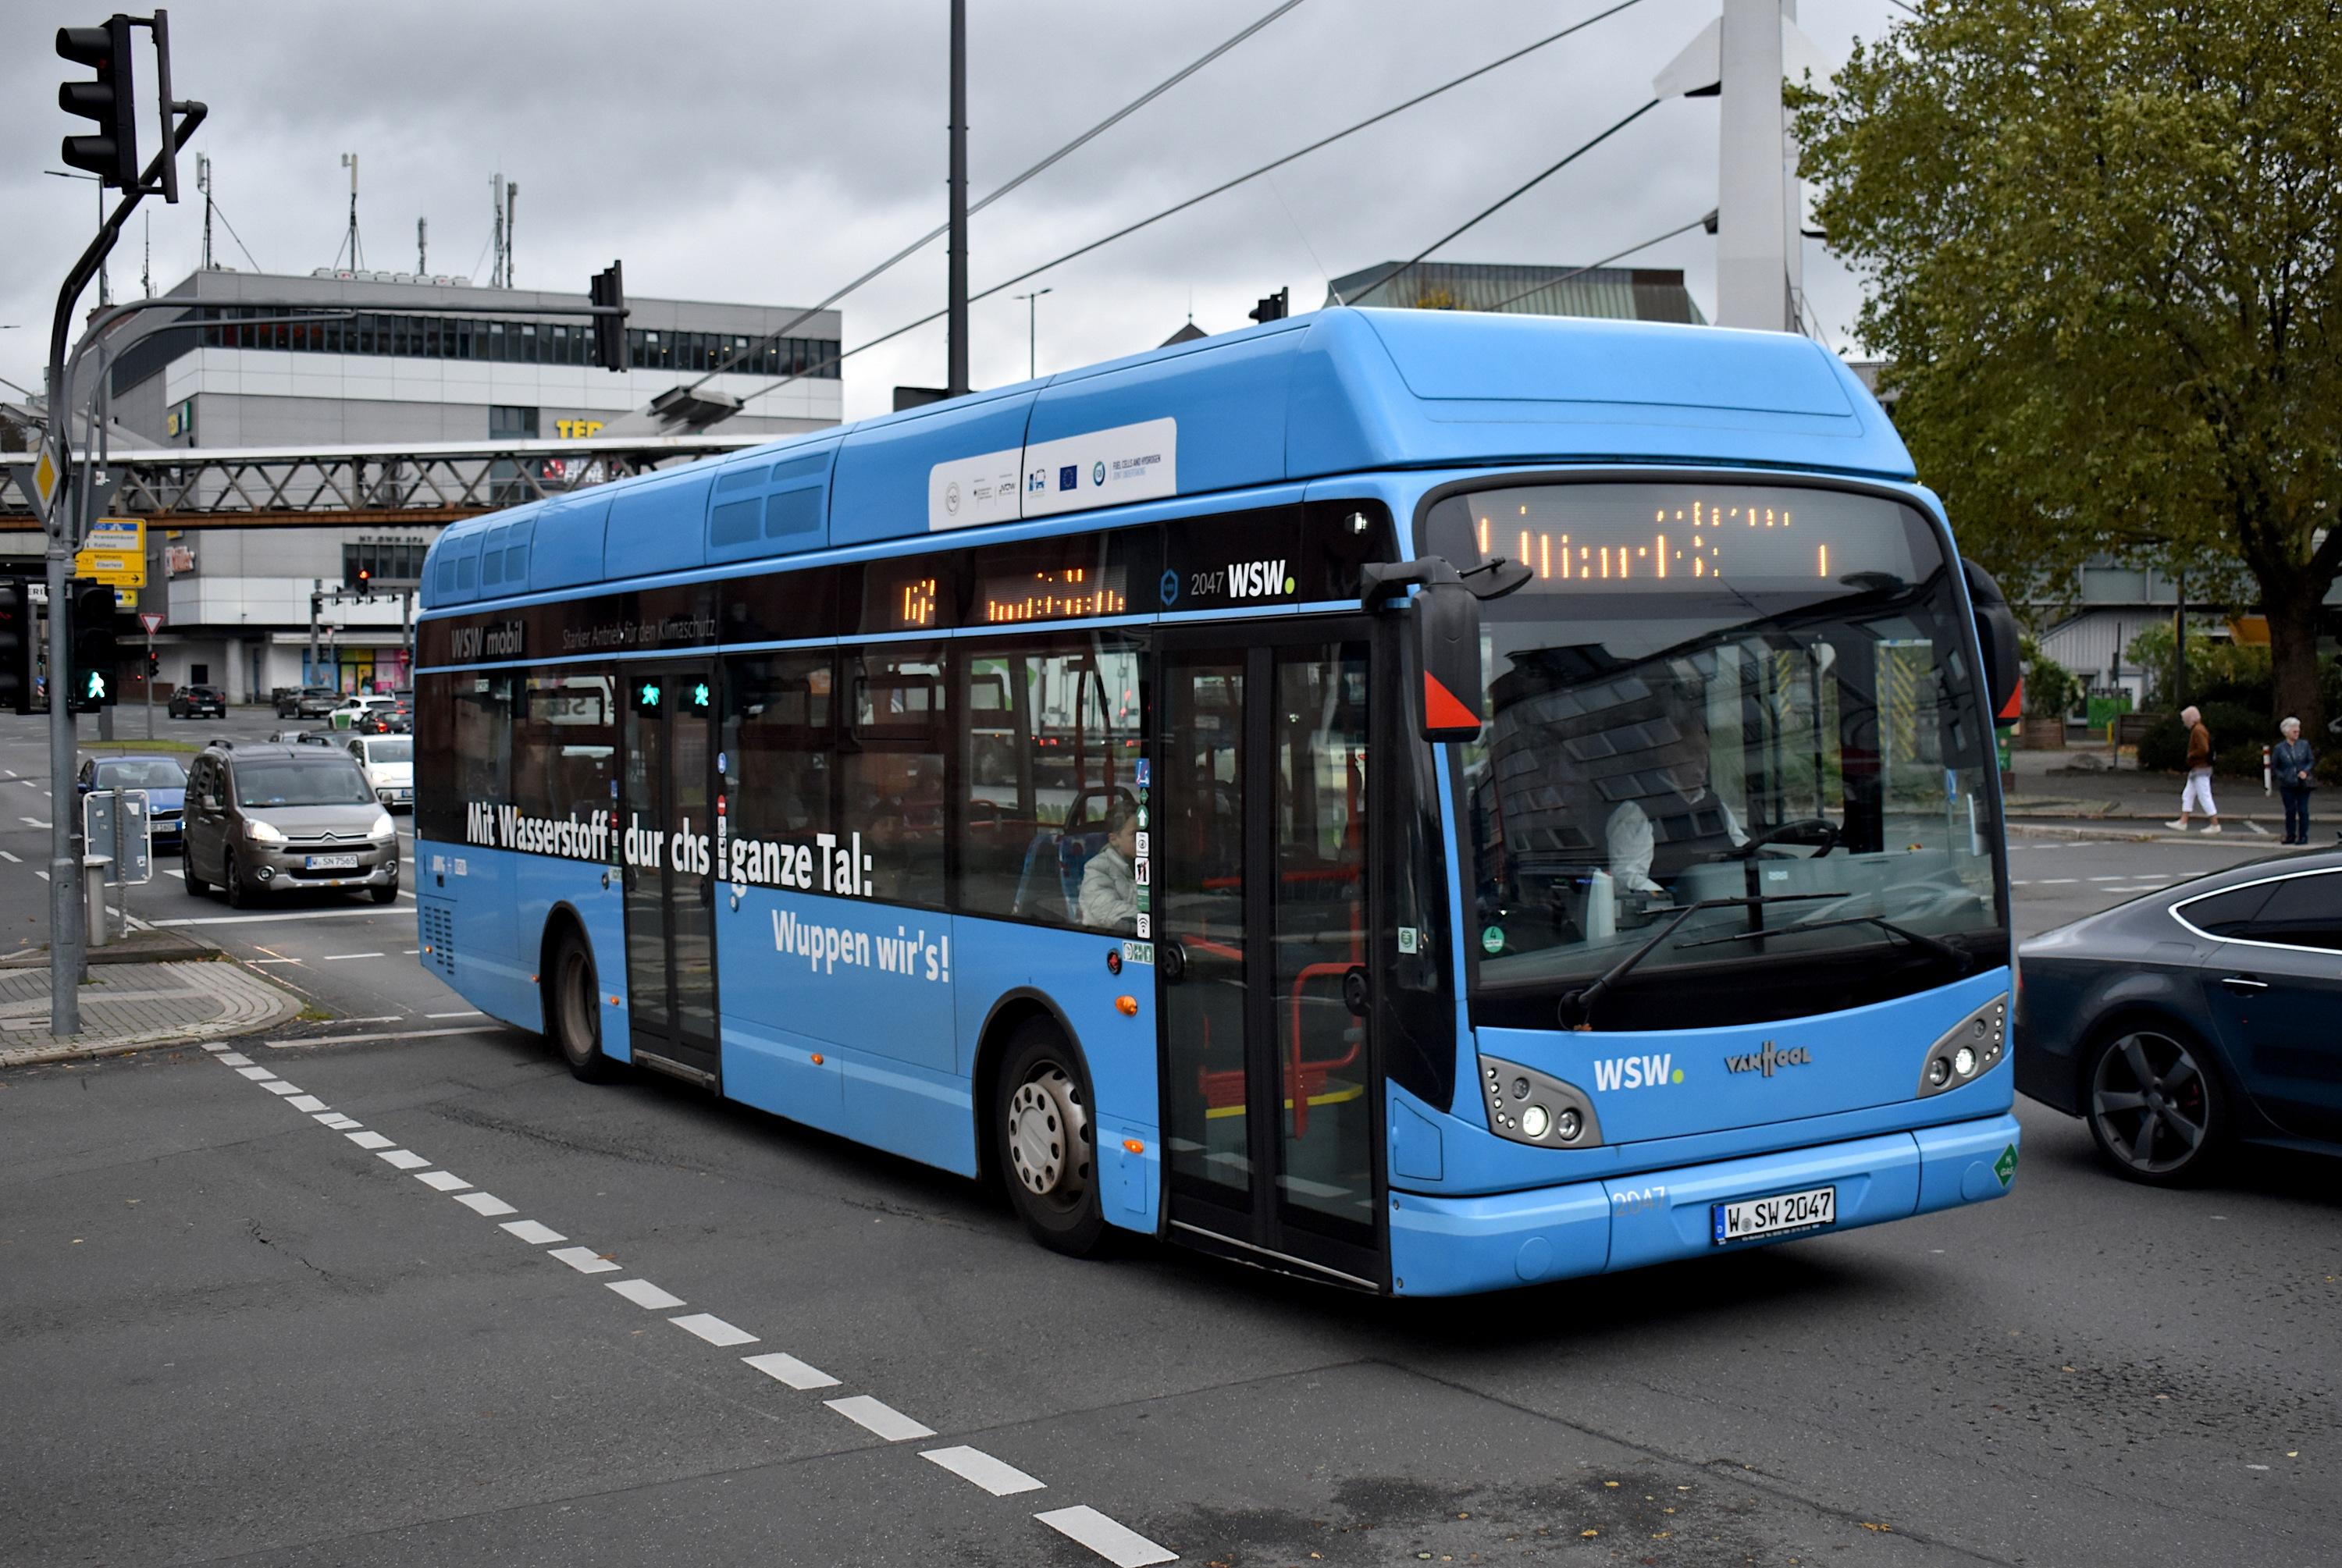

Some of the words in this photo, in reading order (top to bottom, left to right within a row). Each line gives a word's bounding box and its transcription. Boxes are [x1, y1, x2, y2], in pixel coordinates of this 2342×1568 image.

[1191, 571, 1225, 596] 2047
[451, 627, 484, 658] WSW
[486, 620, 523, 656] mobil
[562, 626, 591, 649] Starker
[592, 621, 624, 646] Antrieb
[624, 620, 638, 644] für
[639, 619, 656, 643] den
[658, 613, 716, 641] Klimaschutz
[467, 801, 496, 847] Mit
[497, 804, 608, 861] Wasserstoff
[625, 812, 664, 868] dur
[671, 816, 710, 876] chs
[731, 837, 813, 898] ganze
[817, 831, 873, 898] Tal:
[771, 908, 870, 975] Wuppen
[876, 926, 949, 983] wir's!
[1490, 927, 1497, 940] 4
[2000, 1166, 2015, 1177] GAS
[1612, 1186, 1666, 1218] 2047
[1728, 1207, 1740, 1233] W
[1755, 1200, 1779, 1229] SW
[1785, 1192, 1831, 1223] 2047
